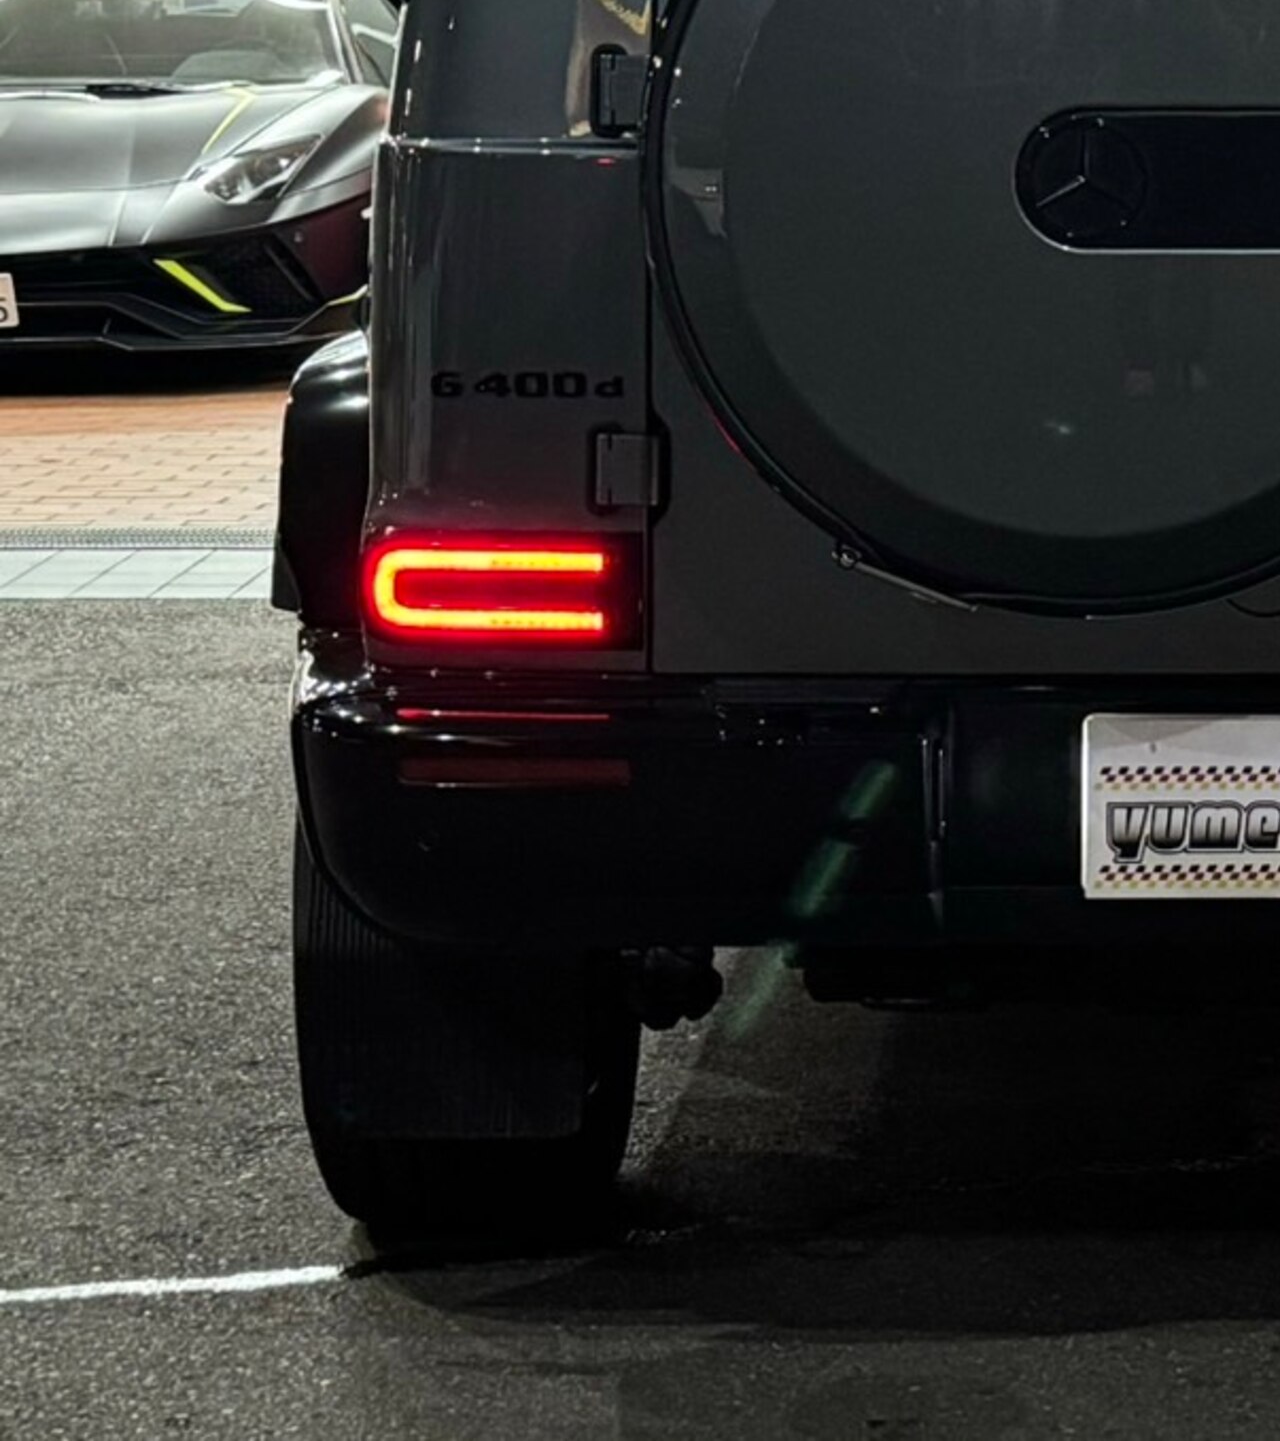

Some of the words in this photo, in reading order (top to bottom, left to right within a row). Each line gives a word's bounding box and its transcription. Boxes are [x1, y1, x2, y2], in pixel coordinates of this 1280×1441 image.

[430, 371, 464, 398] G
[474, 371, 588, 398] 400
[594, 375, 625, 398] d
